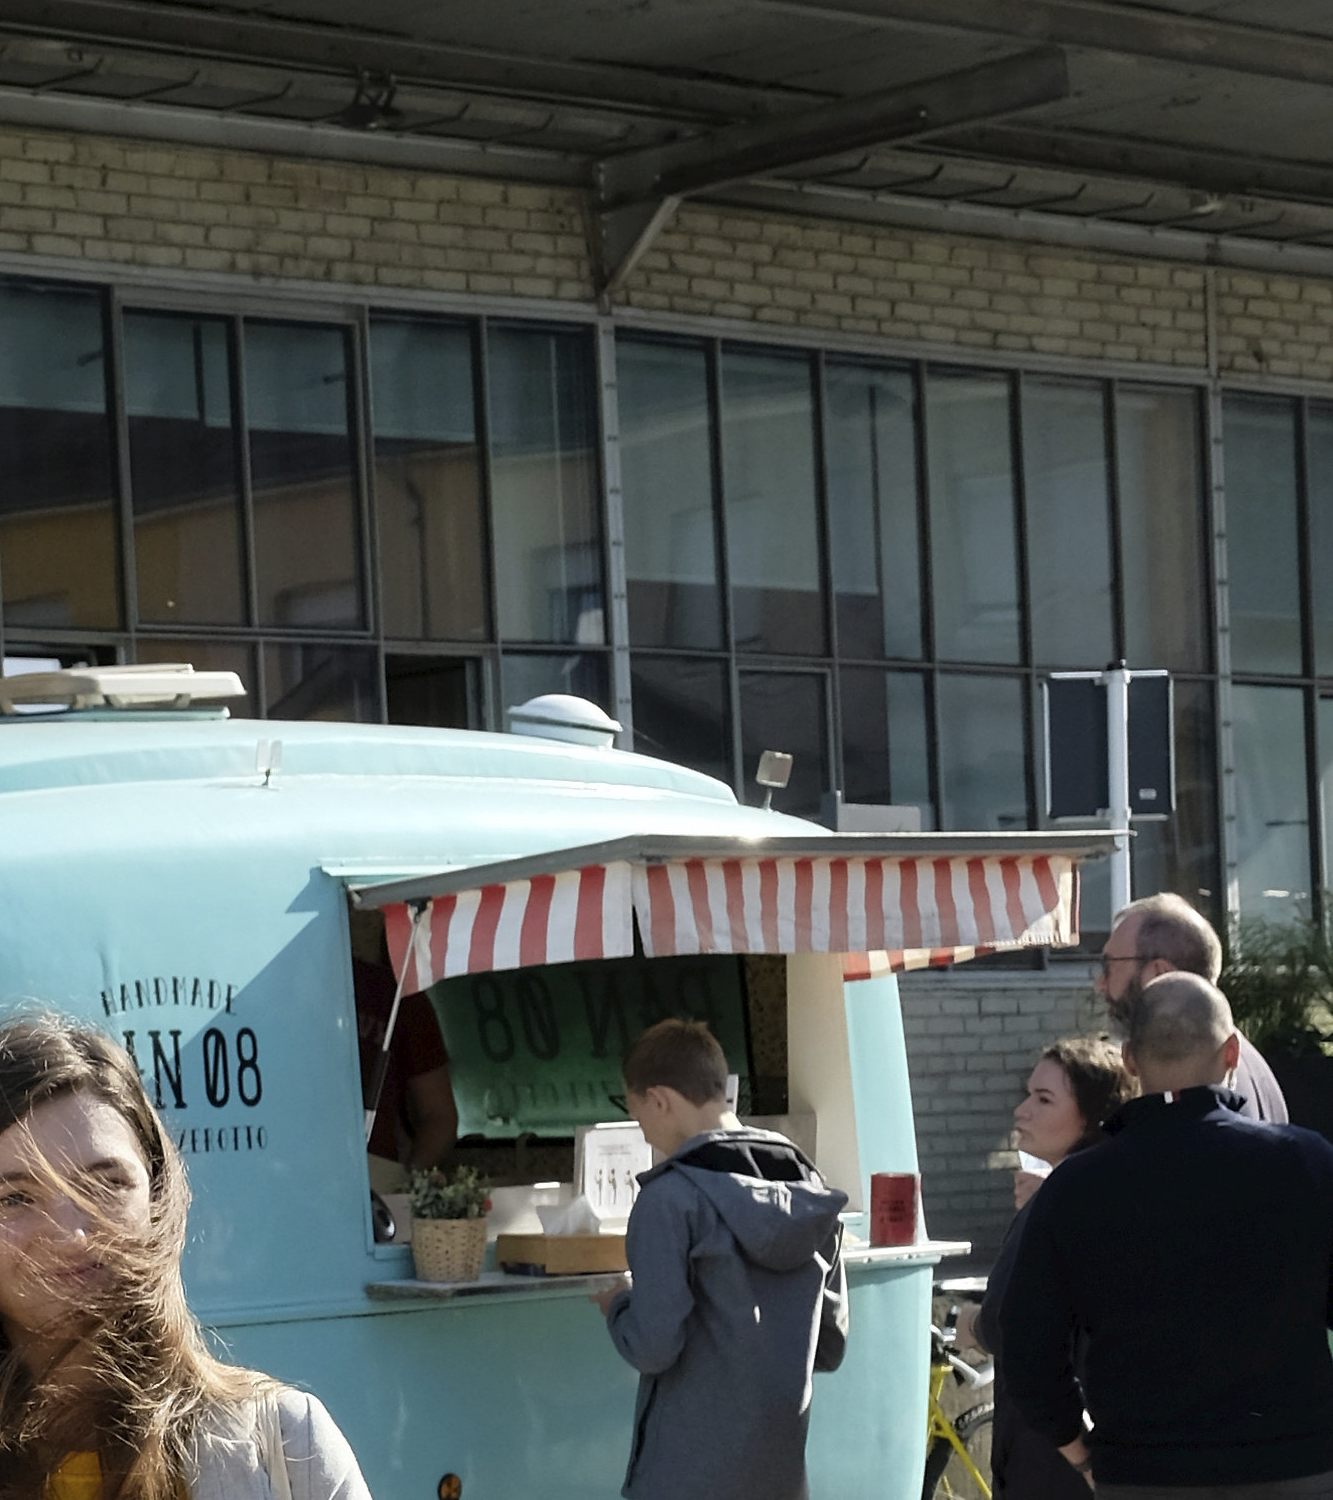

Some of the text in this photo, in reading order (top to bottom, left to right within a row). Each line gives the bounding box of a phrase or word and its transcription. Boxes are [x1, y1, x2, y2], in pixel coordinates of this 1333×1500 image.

[101, 976, 239, 1017] HANDMADE
[202, 1027, 263, 1109] 08
[178, 1125, 269, 1154] ZEROTTO
